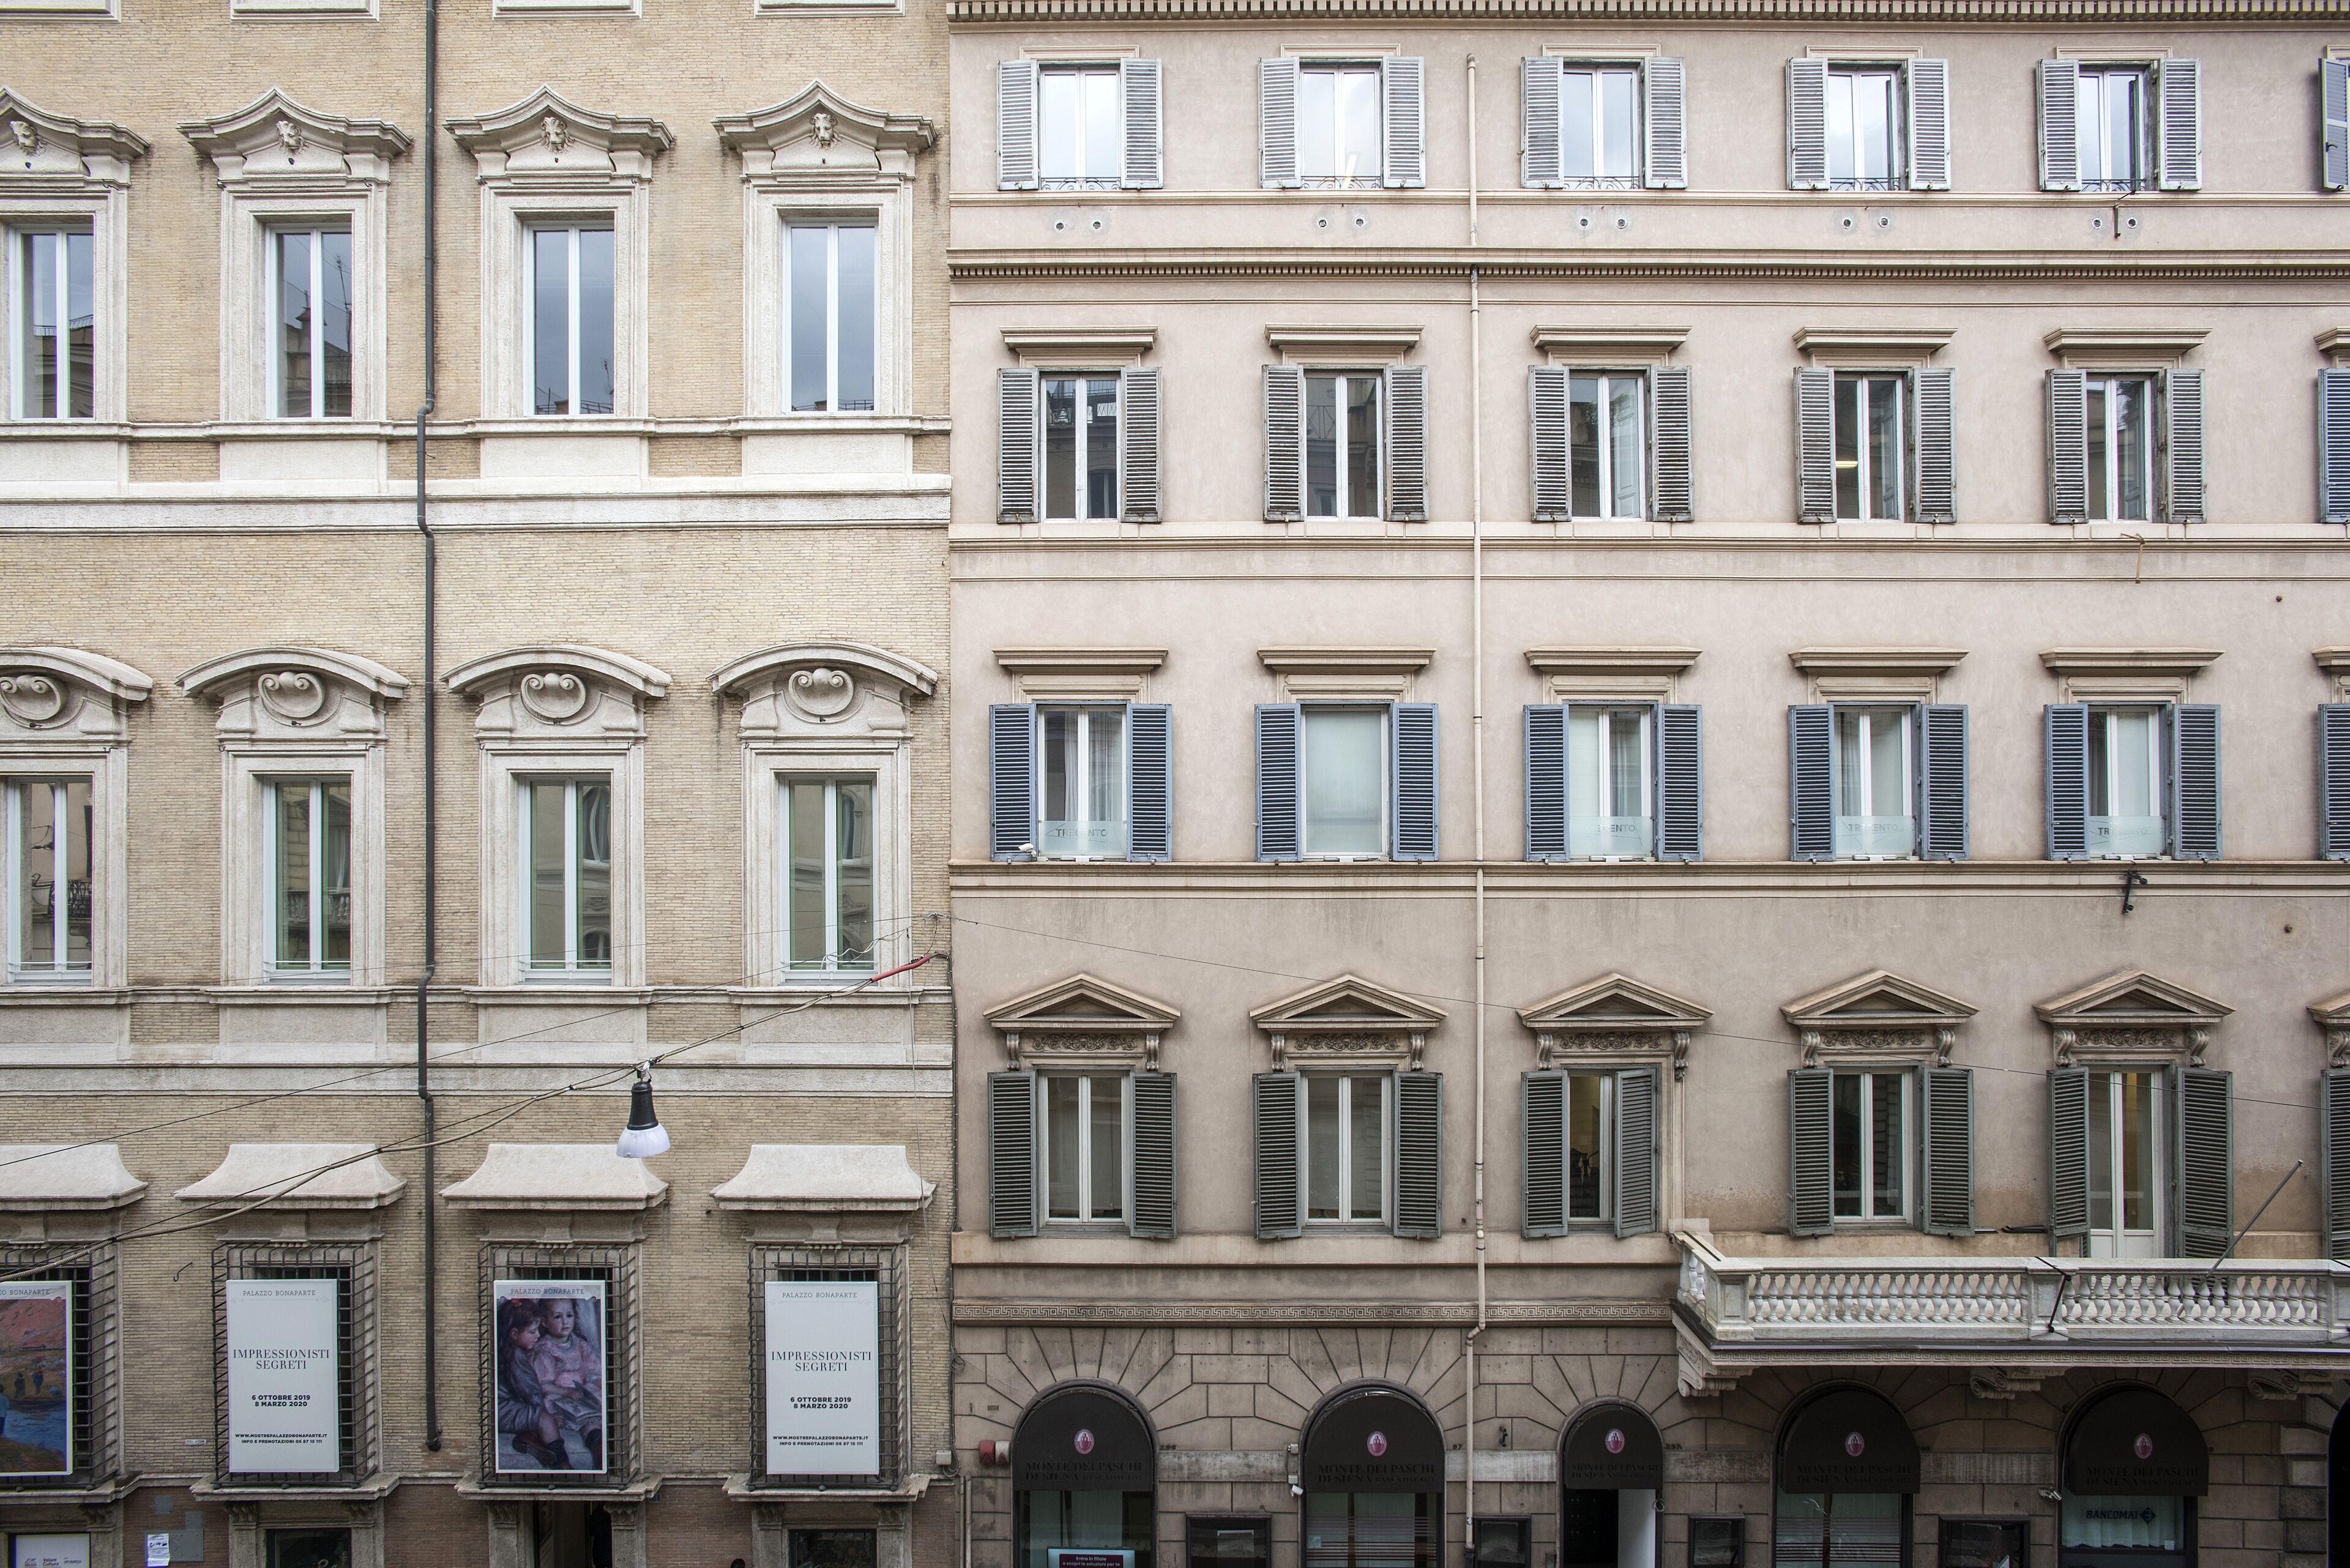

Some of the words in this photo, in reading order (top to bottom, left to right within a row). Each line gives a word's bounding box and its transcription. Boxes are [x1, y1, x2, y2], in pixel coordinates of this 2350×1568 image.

[233, 1349, 329, 1359] IMPRESSIONISTI
[772, 1351, 871, 1361] IMPRESSIONISTI
[256, 1360, 307, 1369] SEGRETI
[795, 1362, 848, 1372] SEGRETI
[1026, 1462, 1070, 1471] MONTE
[1073, 1462, 1095, 1471] DEI
[1099, 1462, 1142, 1471] PASCHI
[1318, 1464, 1363, 1473] MONTE
[1366, 1464, 1387, 1473] DEI
[1390, 1464, 1434, 1473] PASCHI
[2086, 1510, 2138, 1519] BANCOMAT
